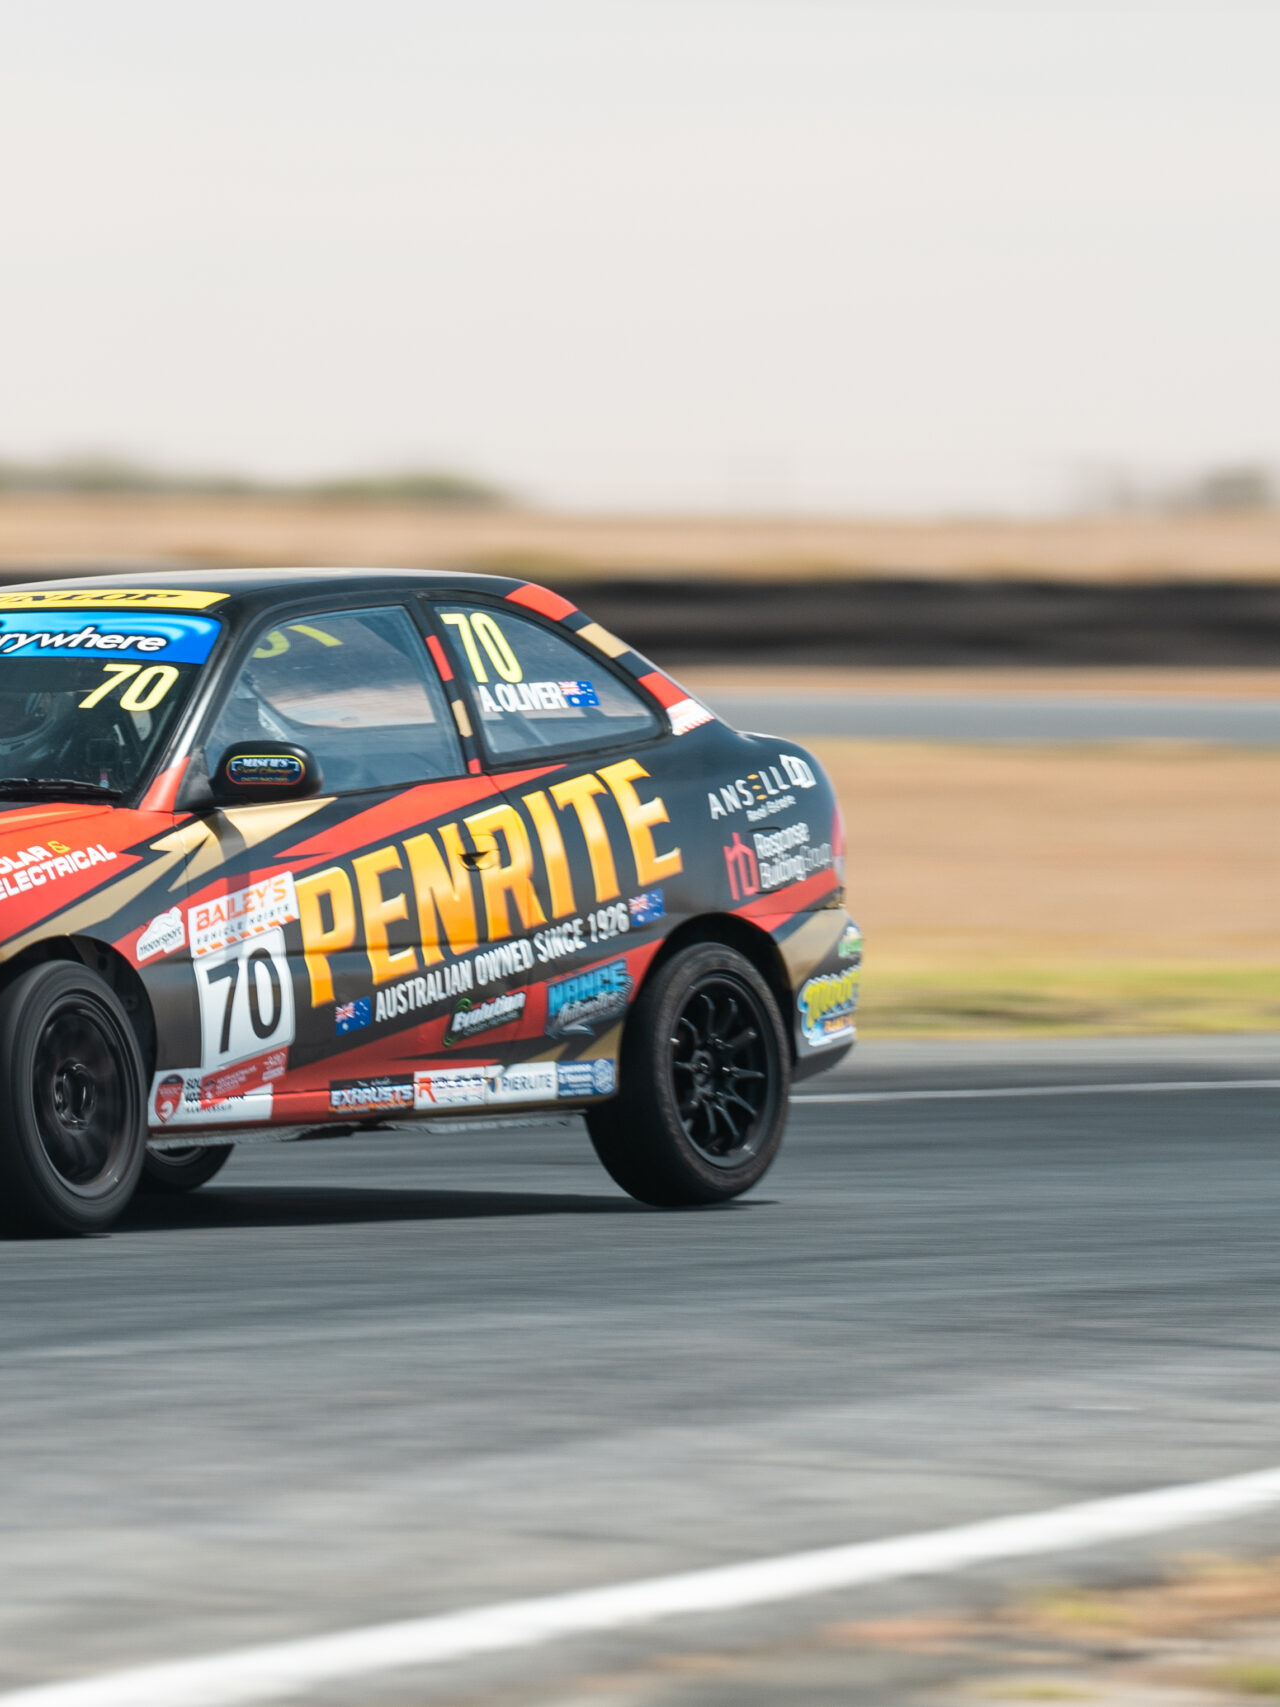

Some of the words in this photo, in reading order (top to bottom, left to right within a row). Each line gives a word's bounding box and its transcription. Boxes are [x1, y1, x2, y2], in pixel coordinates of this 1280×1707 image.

[79, 664, 180, 711] 70
[440, 612, 523, 684] 70
[196, 879, 287, 931] BAILEY'S
[295, 758, 683, 1008] PENRITE
[206, 947, 282, 1054] 70
[375, 960, 472, 1022] AUSTRALIAN
[475, 938, 535, 986] OWNED
[535, 919, 586, 963] SINCE
[587, 902, 630, 943] 1926
